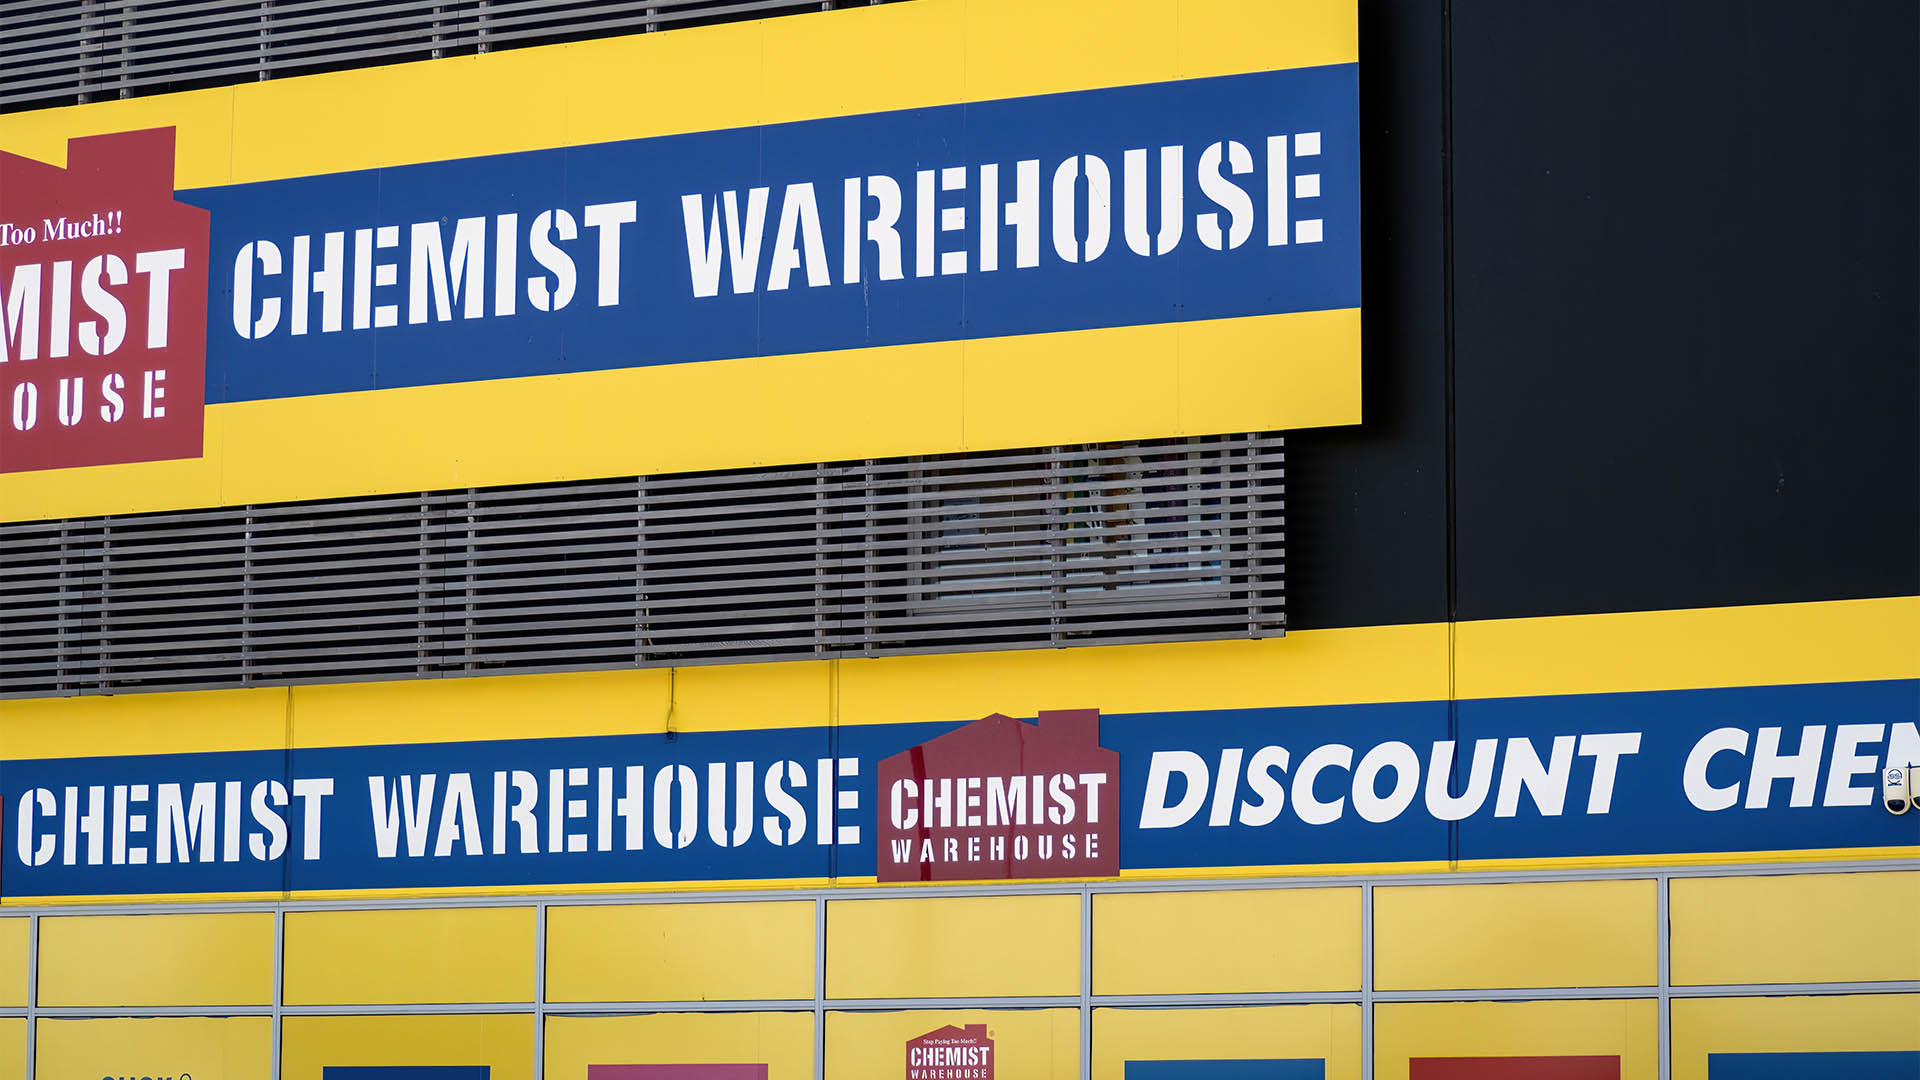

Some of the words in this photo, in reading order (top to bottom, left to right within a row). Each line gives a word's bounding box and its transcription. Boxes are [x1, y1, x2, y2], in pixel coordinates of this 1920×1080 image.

[0, 223, 36, 247] Too
[42, 210, 122, 242] Much!!
[233, 200, 637, 340] CHEMIST
[680, 131, 1324, 298] WAREHOUSE
[12, 369, 166, 431] OUSE
[890, 772, 1107, 830] CHEMIST
[1139, 731, 1642, 829] DISCOUNT
[17, 777, 334, 867] CHEMIST
[368, 757, 860, 858] WAREHOUSE
[891, 833, 1099, 864] WAREHOUSE
[910, 1046, 990, 1067] CHEMIST
[911, 1068, 987, 1080] WAREHOUSE
